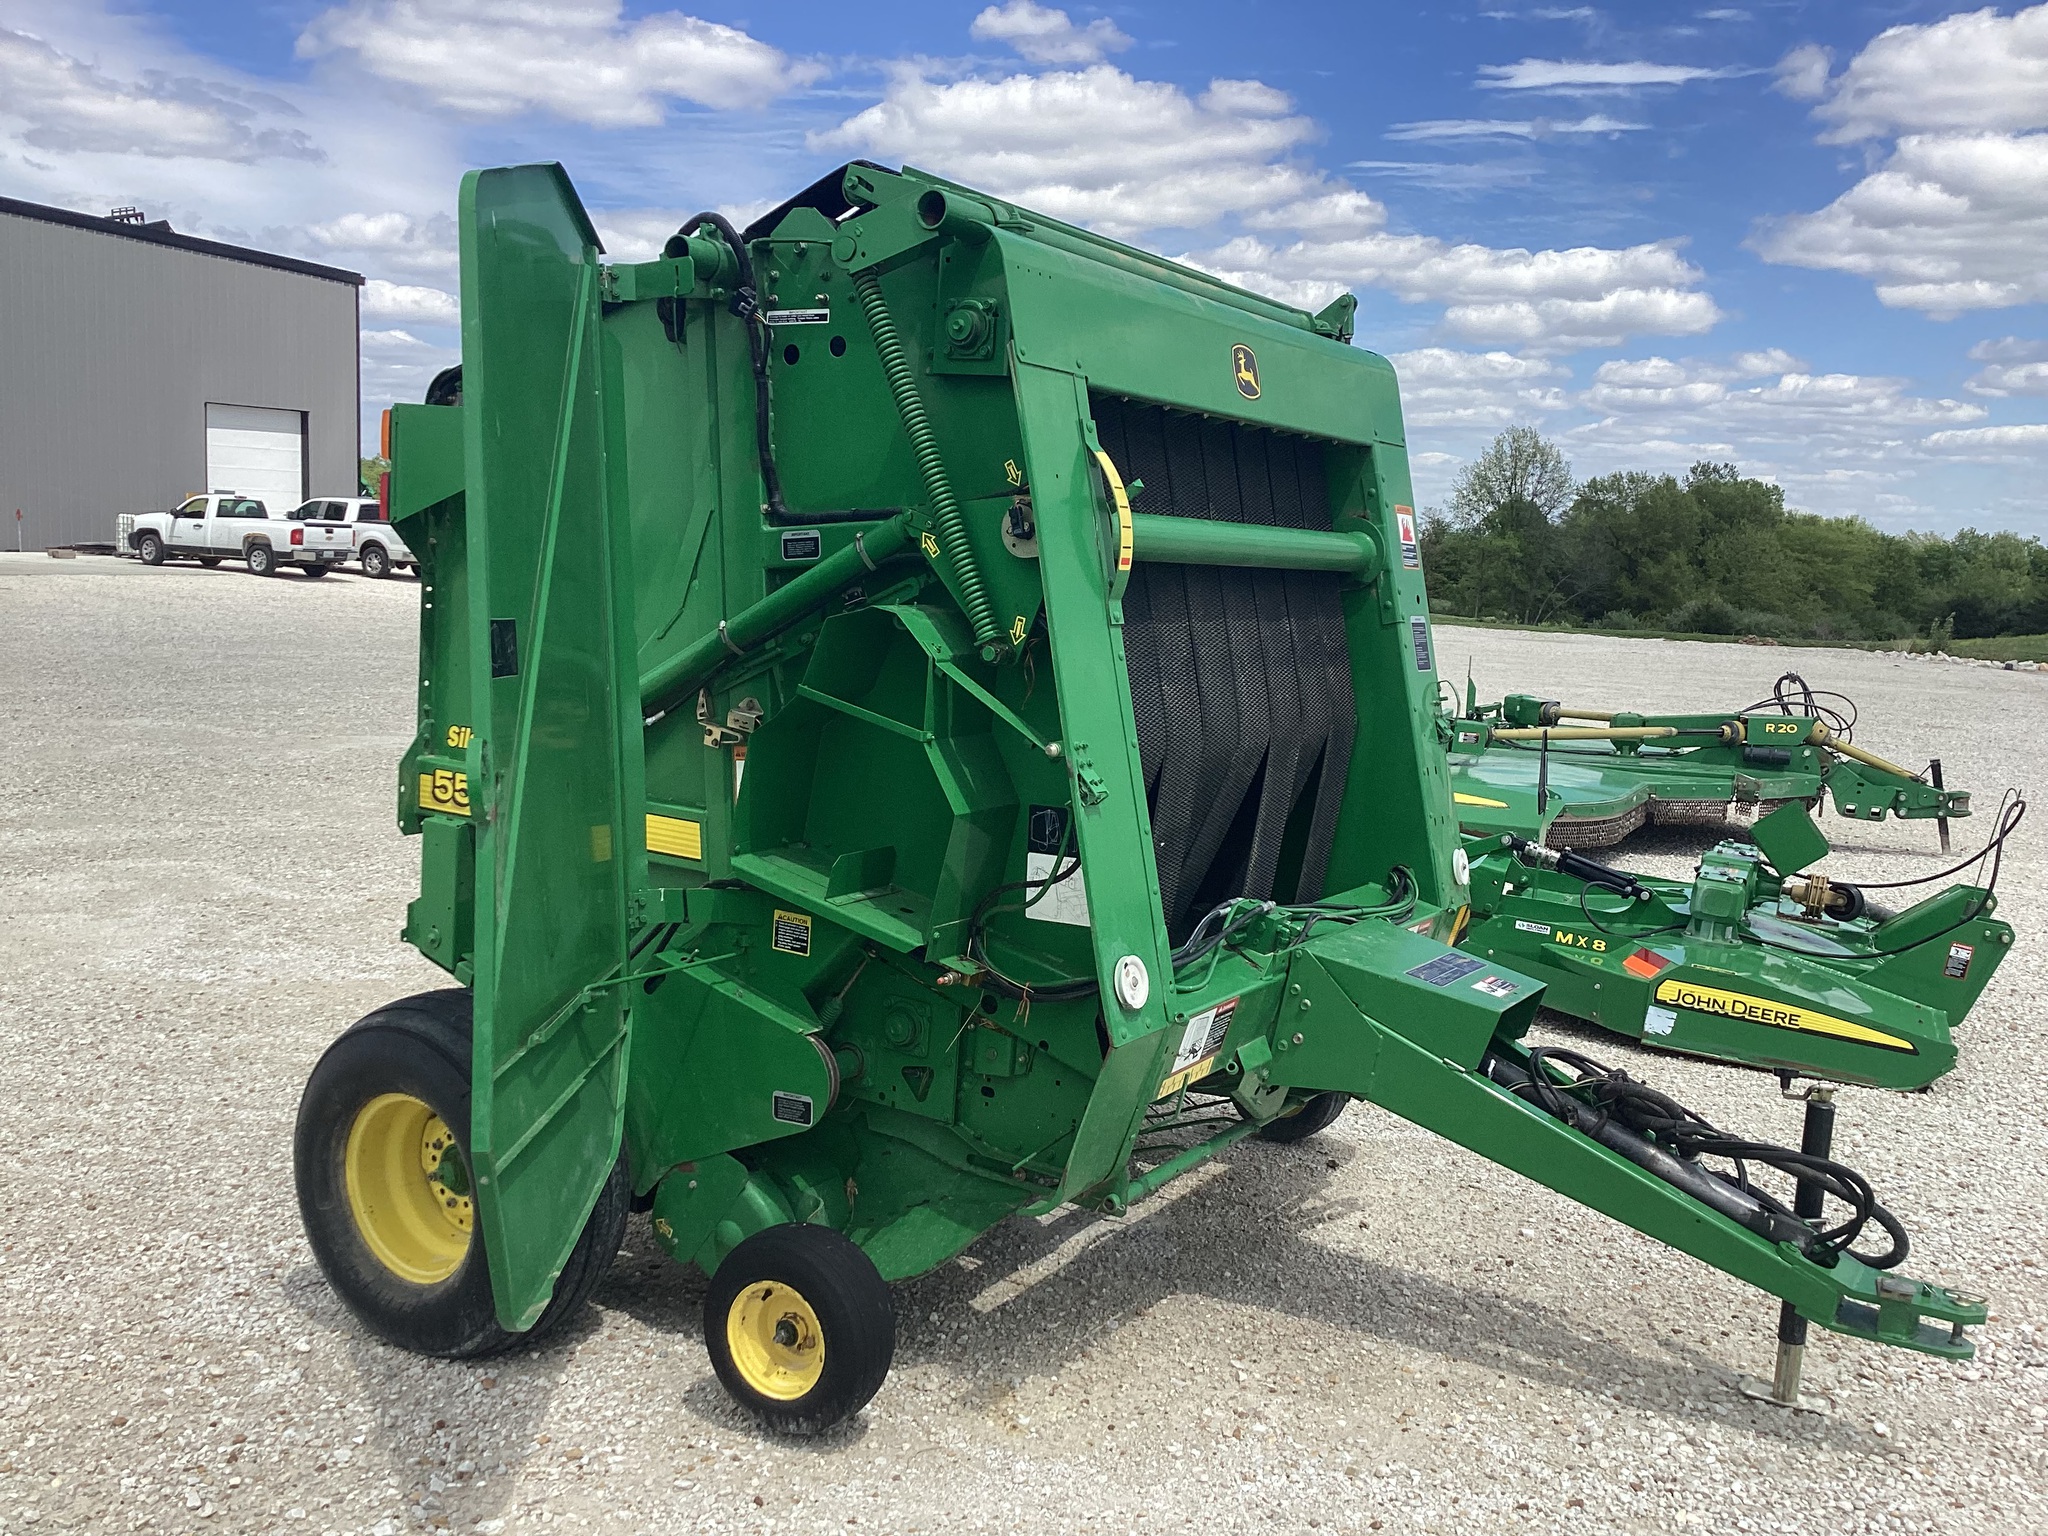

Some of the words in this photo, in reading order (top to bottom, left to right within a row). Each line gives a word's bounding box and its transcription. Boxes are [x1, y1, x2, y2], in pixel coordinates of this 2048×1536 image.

[446, 725, 475, 749] Sil
[782, 914, 808, 925] CAUTION
[1669, 989, 1726, 1010] JOHN
[1731, 1000, 1801, 1026] DEERE
